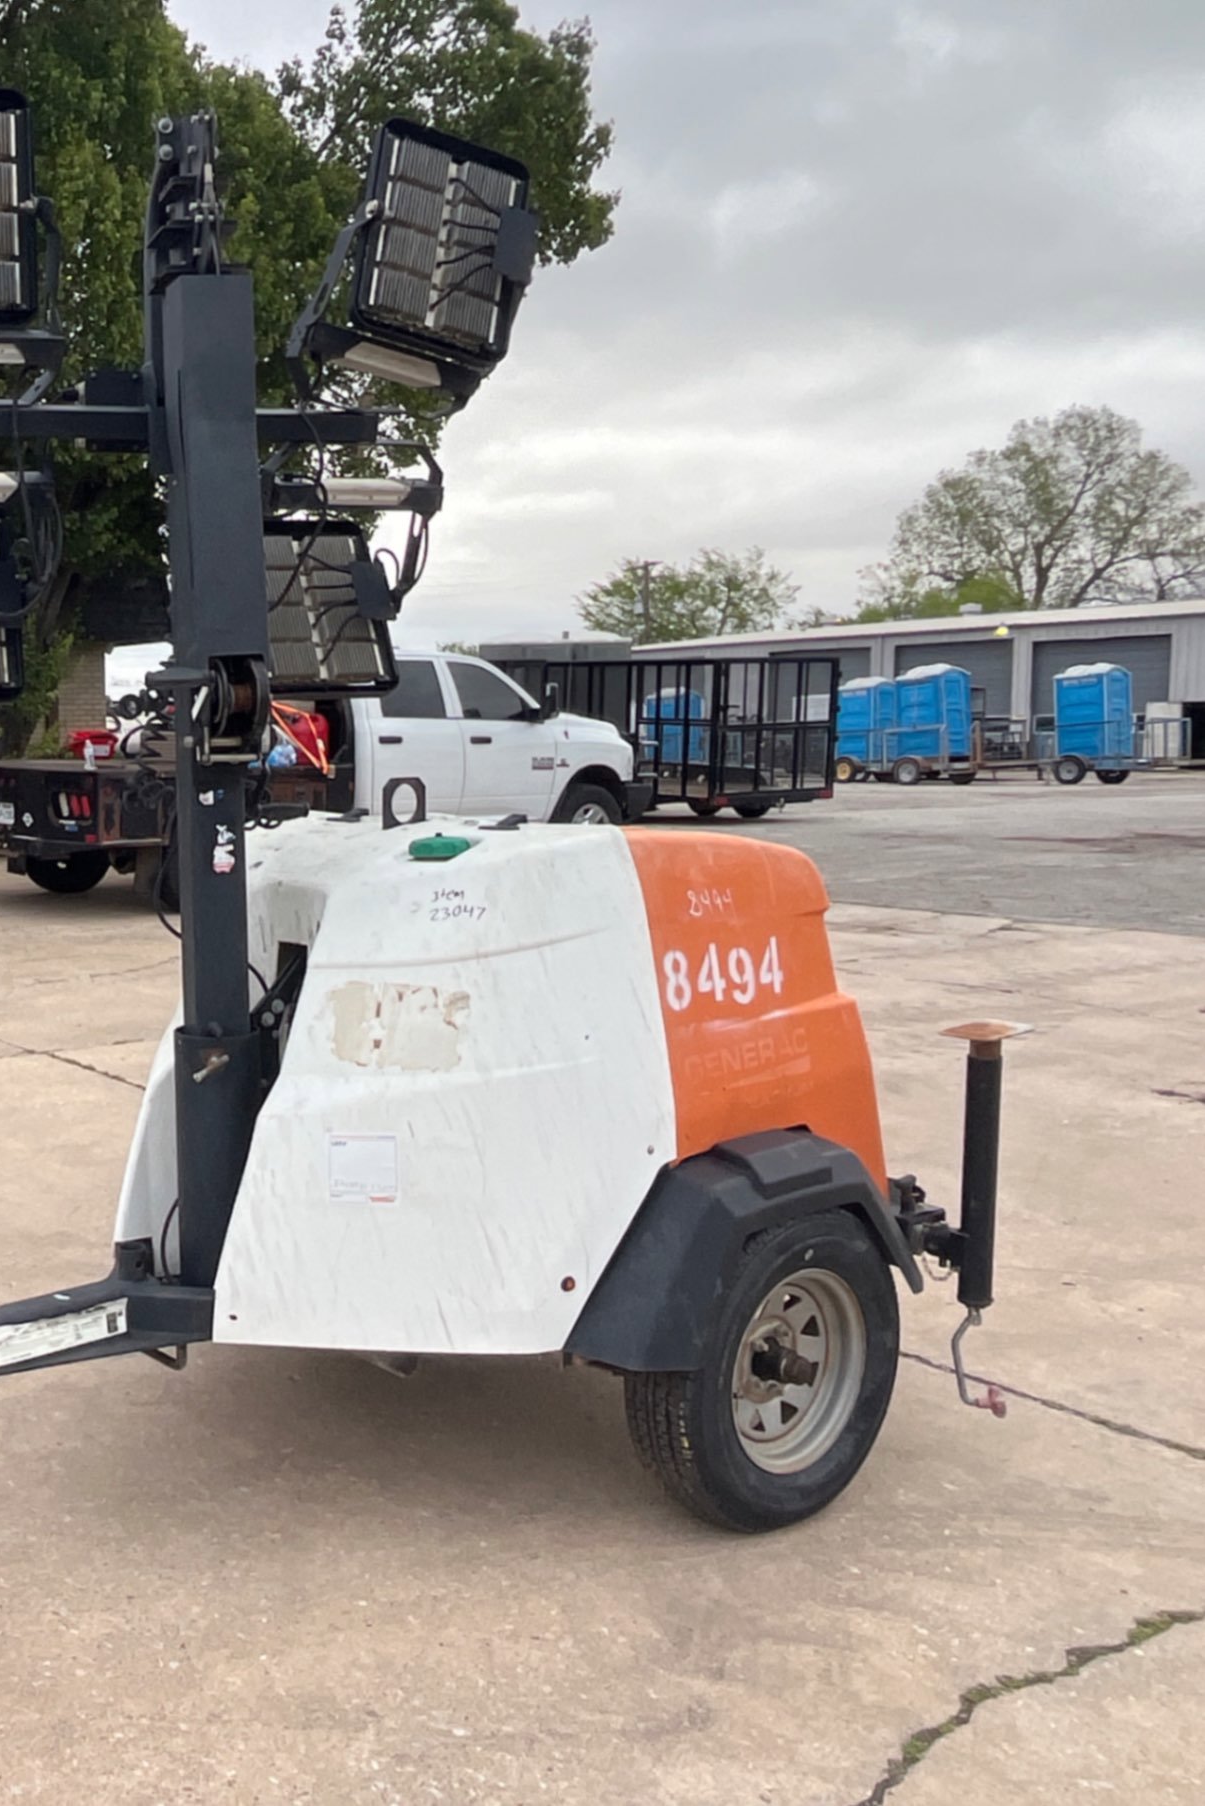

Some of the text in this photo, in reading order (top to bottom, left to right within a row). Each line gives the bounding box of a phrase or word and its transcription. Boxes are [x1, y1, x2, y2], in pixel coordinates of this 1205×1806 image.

[429, 905, 486, 921] 23047
[687, 888, 736, 917] 8494
[663, 936, 783, 1011] 8494
